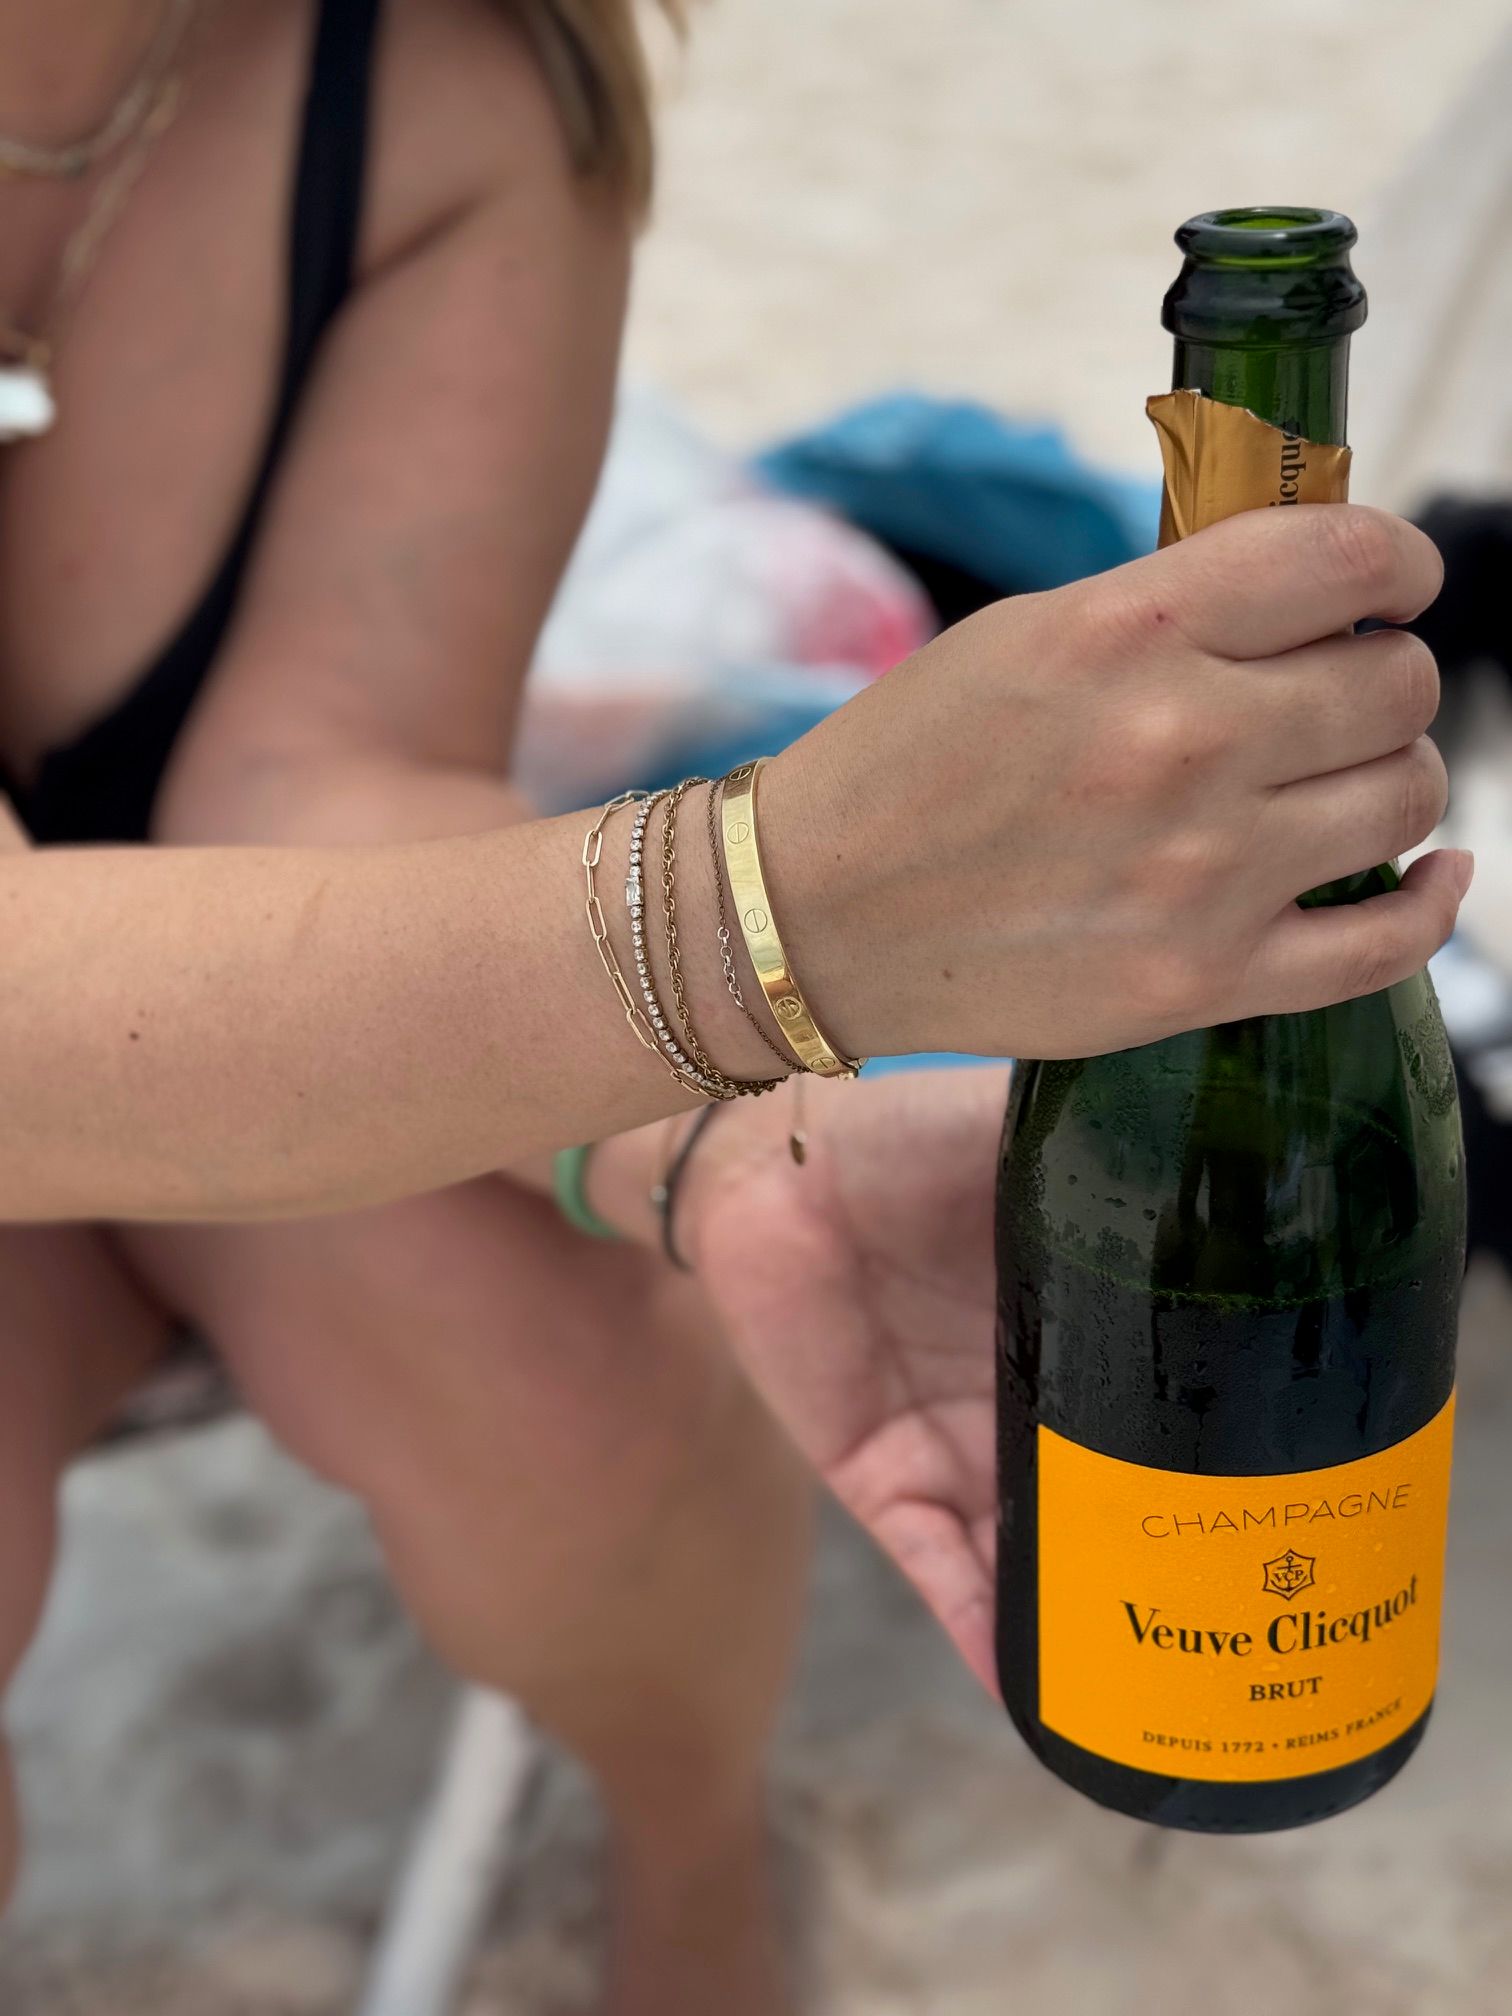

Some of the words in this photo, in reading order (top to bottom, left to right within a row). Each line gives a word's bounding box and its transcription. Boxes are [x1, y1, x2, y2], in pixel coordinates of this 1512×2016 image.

[1141, 1483, 1412, 1538] CHAMPAGNE
[1122, 1601, 1253, 1657] Veuve
[1268, 1576, 1418, 1655] Clicquot
[1248, 1676, 1323, 1702] BRUT
[1141, 1730, 1212, 1752] DEPUIS
[1221, 1740, 1265, 1754] 1772
[1285, 1728, 1340, 1750] REIMS
[1346, 1699, 1401, 1734] FRANCE
